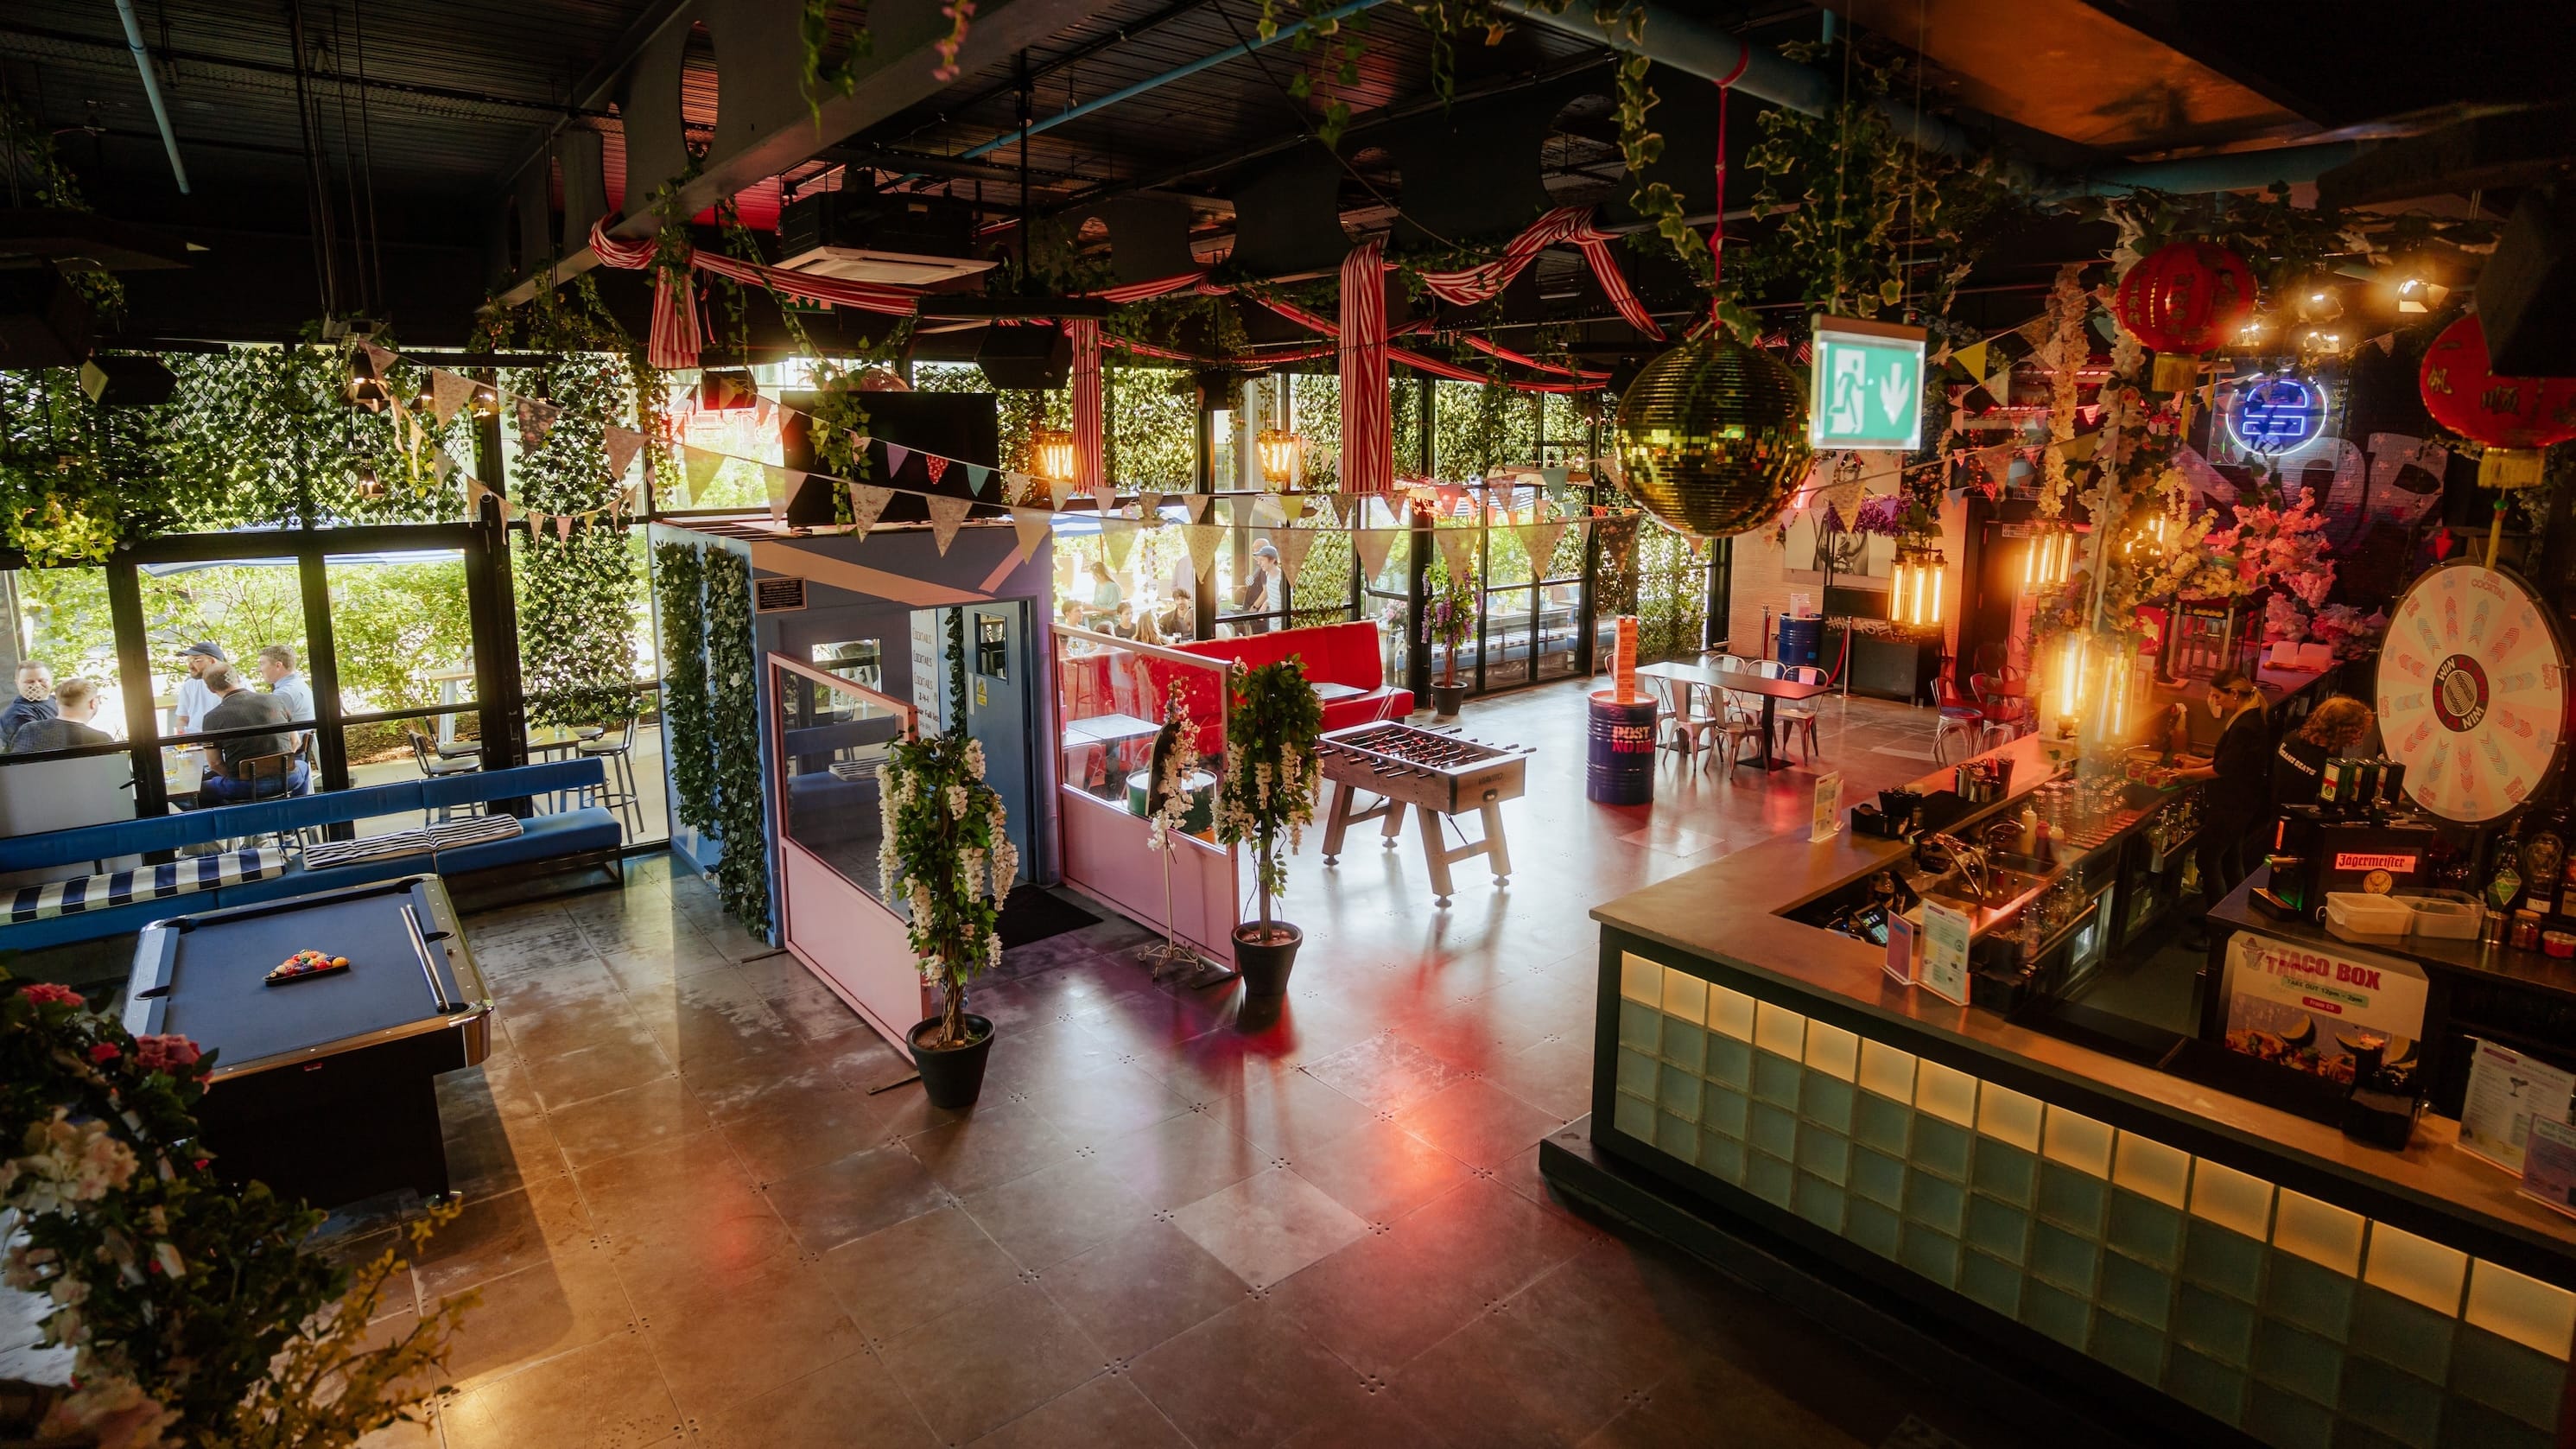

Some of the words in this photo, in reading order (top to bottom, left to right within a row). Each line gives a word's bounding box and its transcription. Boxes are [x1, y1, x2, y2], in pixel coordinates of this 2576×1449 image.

[2437, 658, 2456, 682] WIN
[2462, 705, 2485, 729] WIN
[1612, 726, 1650, 740] POST
[1612, 739, 1634, 753] NO
[2274, 948, 2330, 976] TACO
[2336, 963, 2381, 990] BOX
[2305, 983, 2319, 992] OUT
[2321, 988, 2339, 997] 12pm
